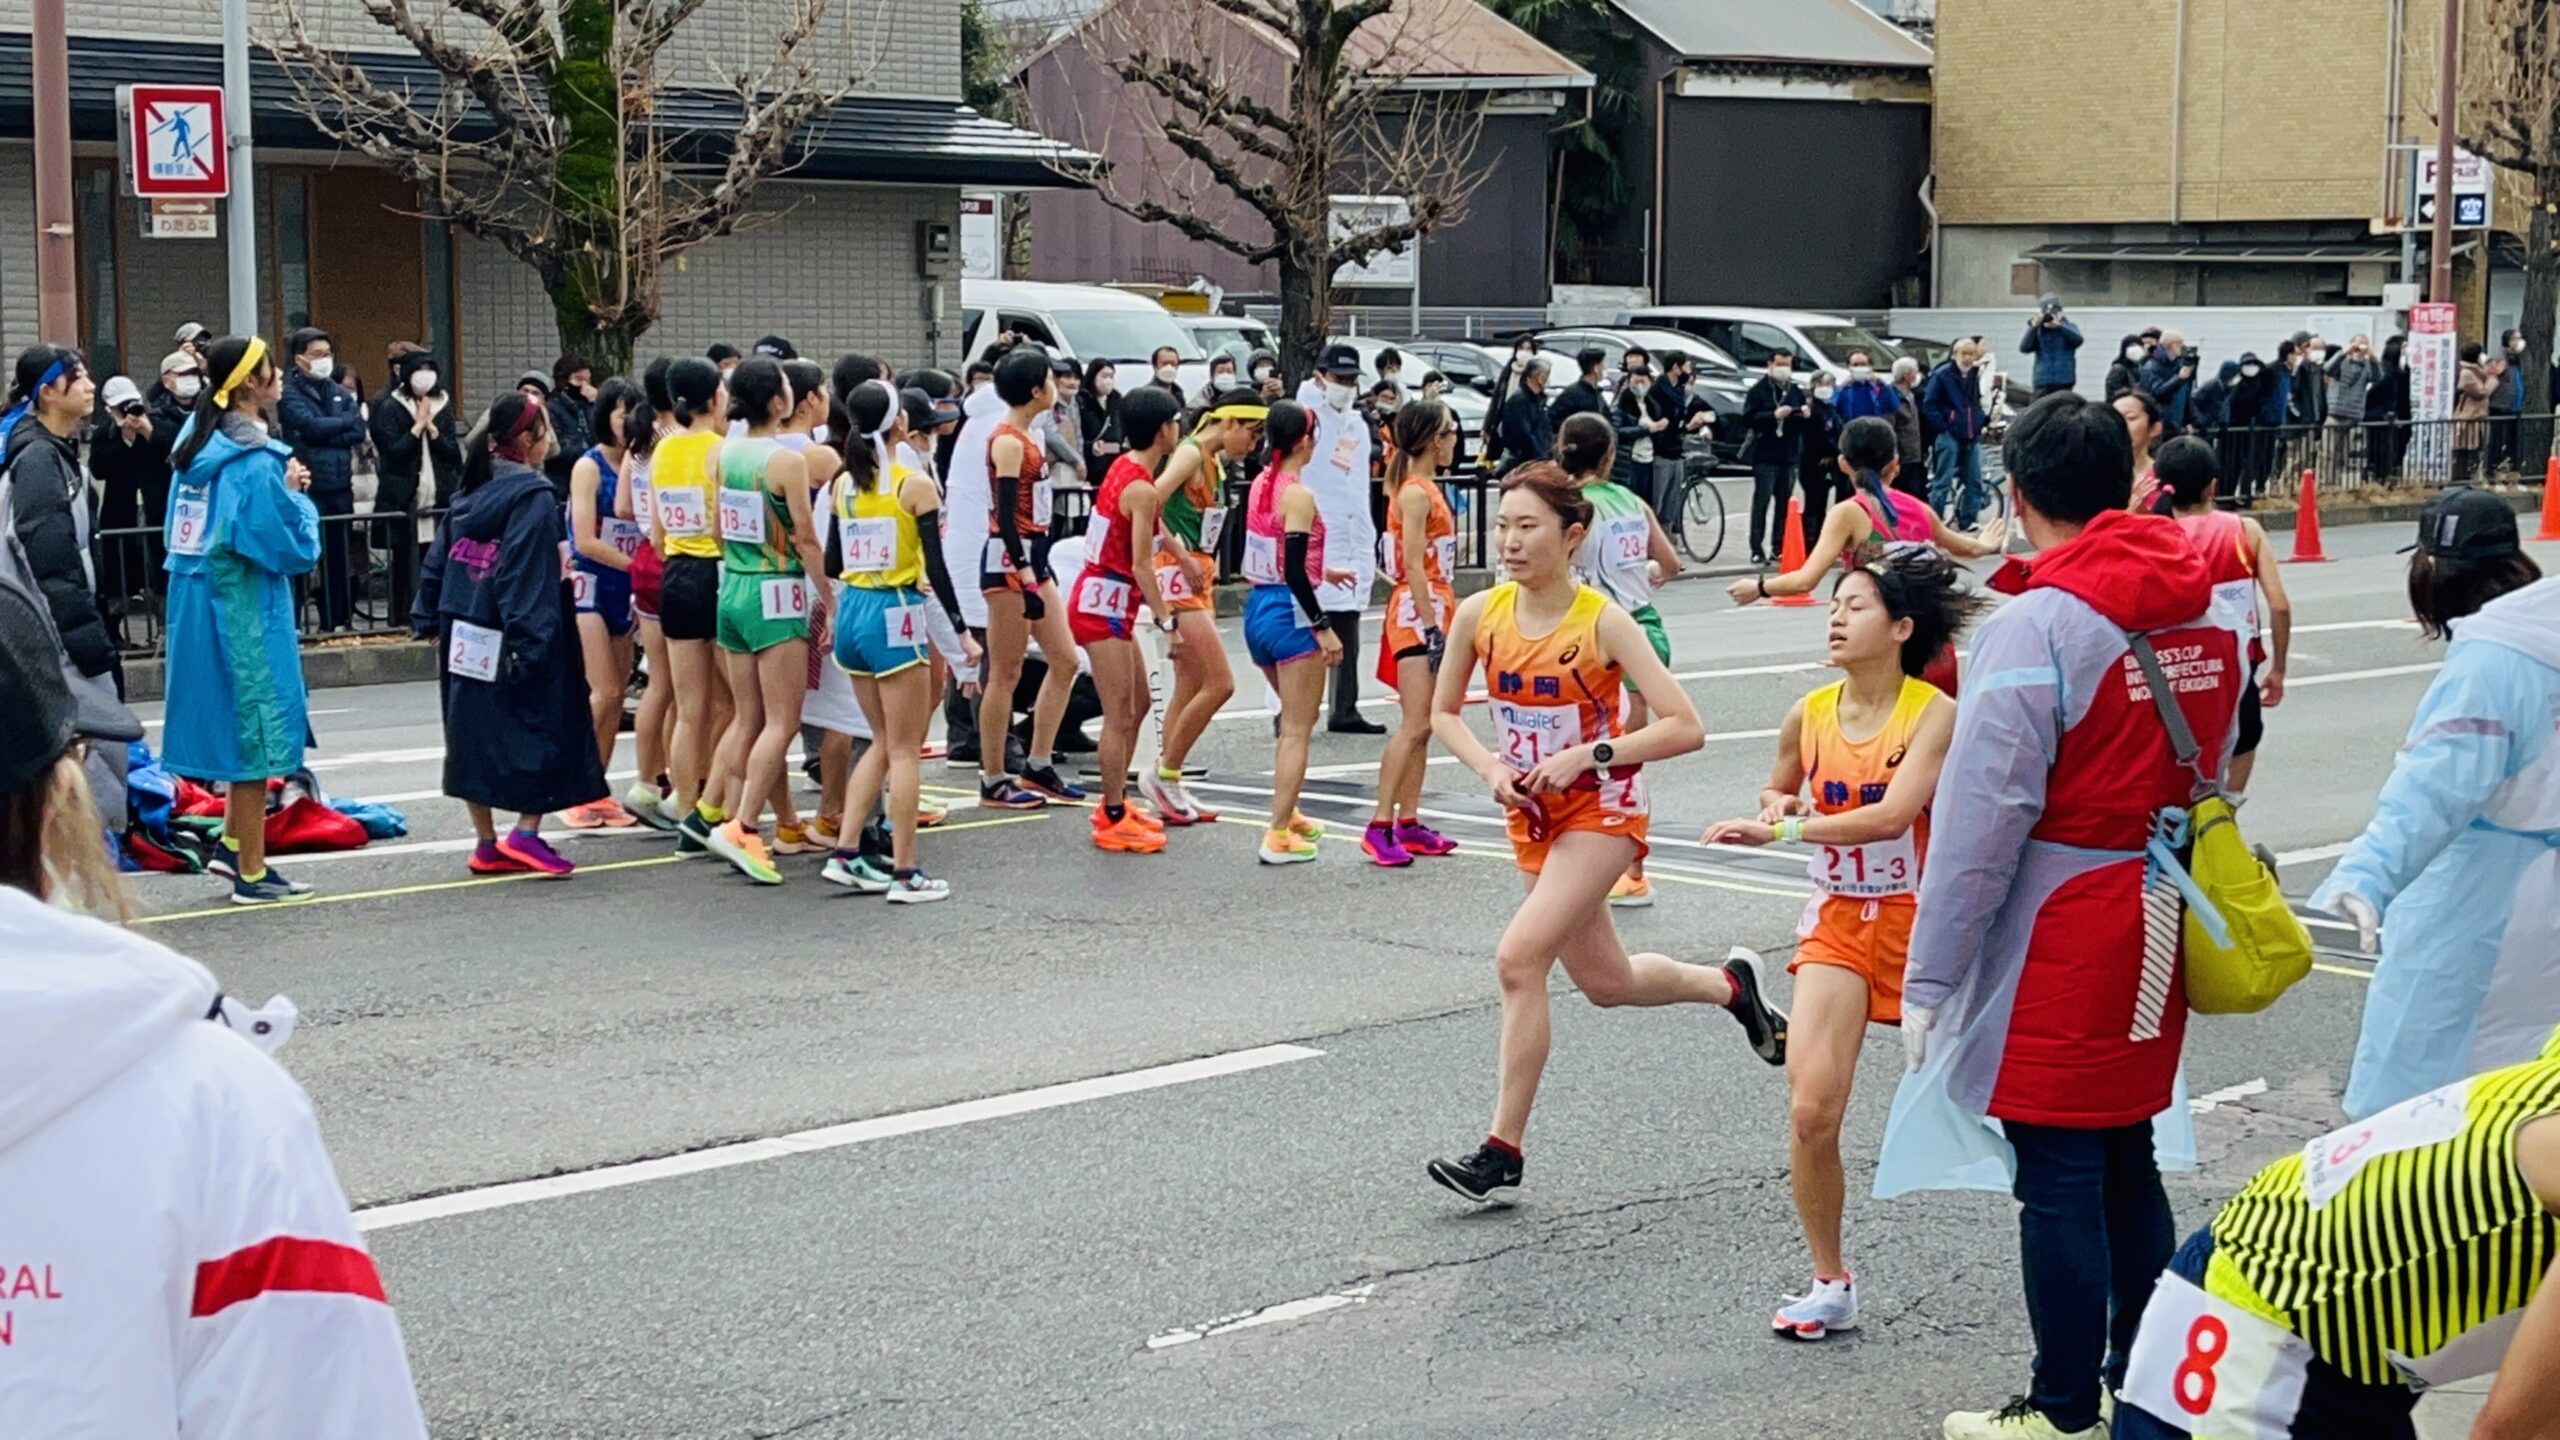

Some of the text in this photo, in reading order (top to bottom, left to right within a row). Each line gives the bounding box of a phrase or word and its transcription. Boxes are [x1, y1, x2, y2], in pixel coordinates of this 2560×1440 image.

[664, 506, 702, 527] 29-4
[723, 508, 758, 532] 18-4
[181, 521, 193, 544] 9
[849, 538, 890, 560] 41-4
[1088, 583, 1121, 613] 34
[901, 612, 914, 640] 4
[454, 642, 490, 670] 2-4
[1507, 728, 1570, 763] 21-
[1824, 845, 1906, 882] 21-3
[2330, 1131, 2373, 1165] 3
[2173, 1314, 2229, 1416] 8
